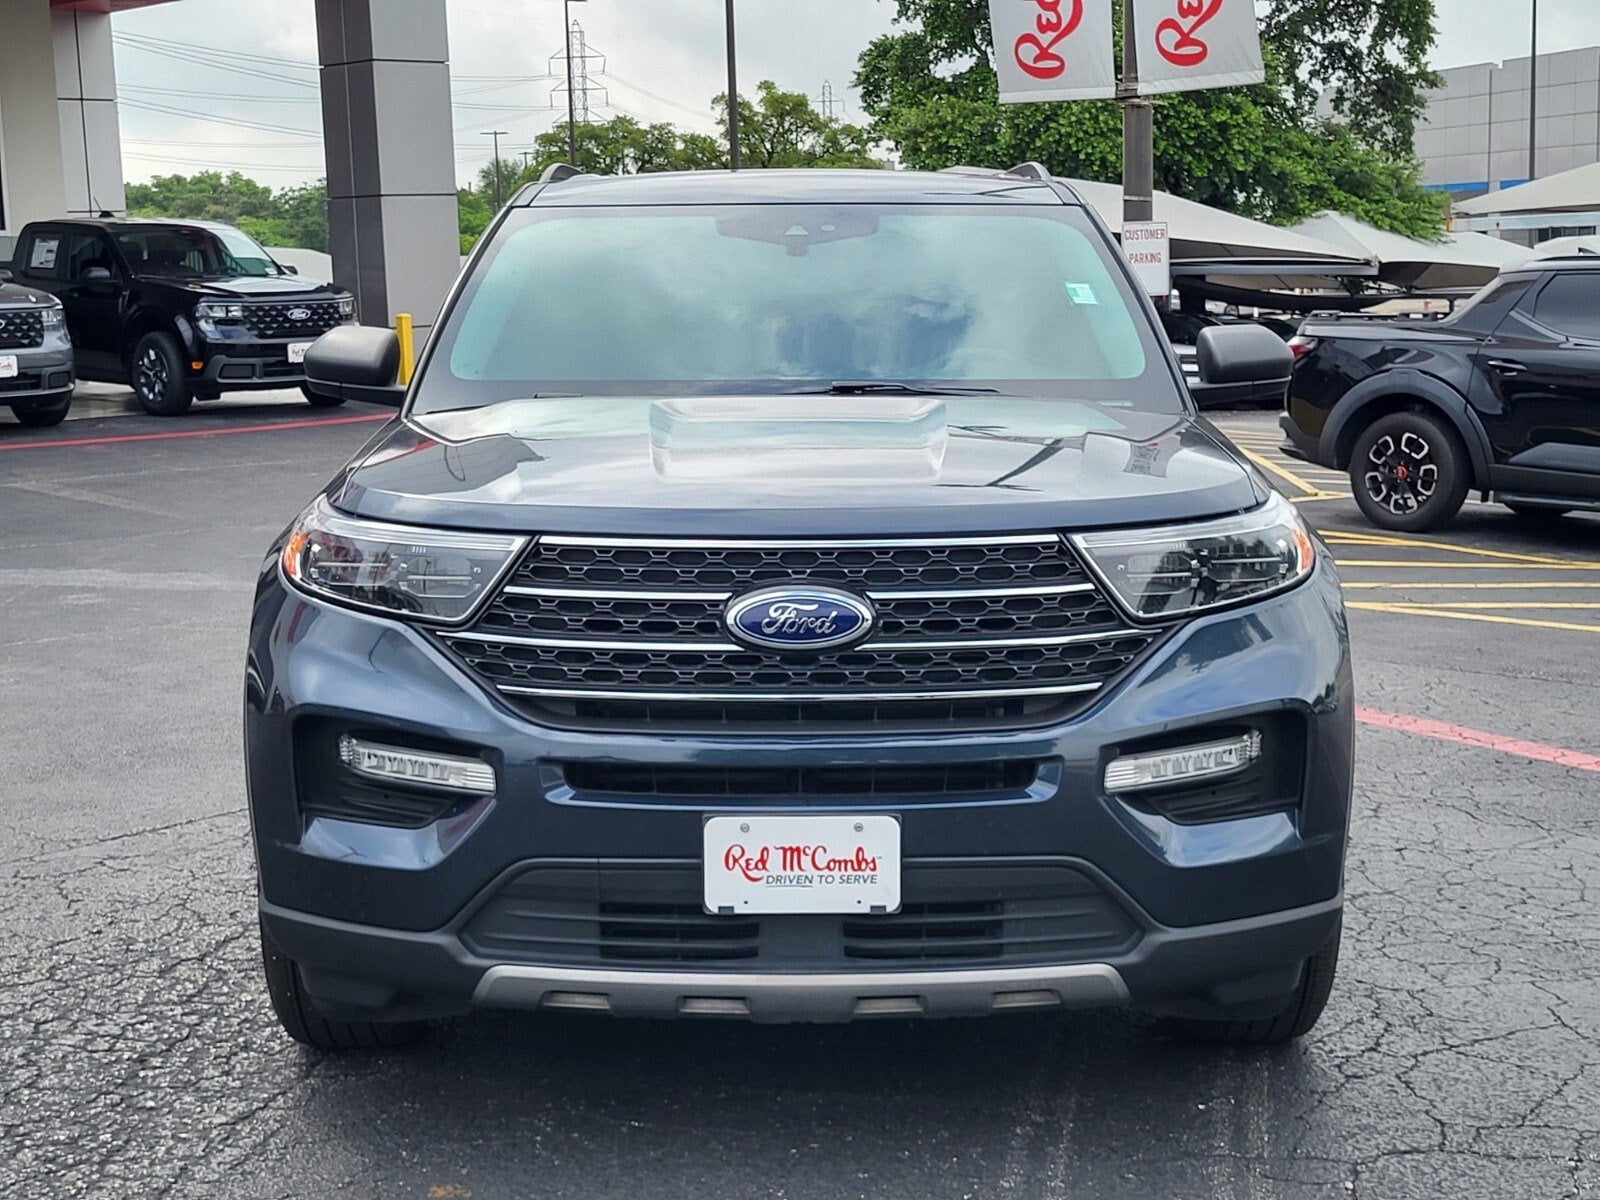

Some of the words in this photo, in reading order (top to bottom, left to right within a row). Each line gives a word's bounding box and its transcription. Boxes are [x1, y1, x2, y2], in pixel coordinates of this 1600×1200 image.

[1124, 229, 1165, 241] CUSTOMER
[1129, 252, 1162, 264] PARKING
[761, 602, 838, 634] Ford
[724, 844, 771, 882] Red
[774, 846, 877, 872] McCombs
[766, 875, 815, 885] DRIVEN
[818, 875, 835, 885] TO
[838, 875, 878, 885] SERVE
